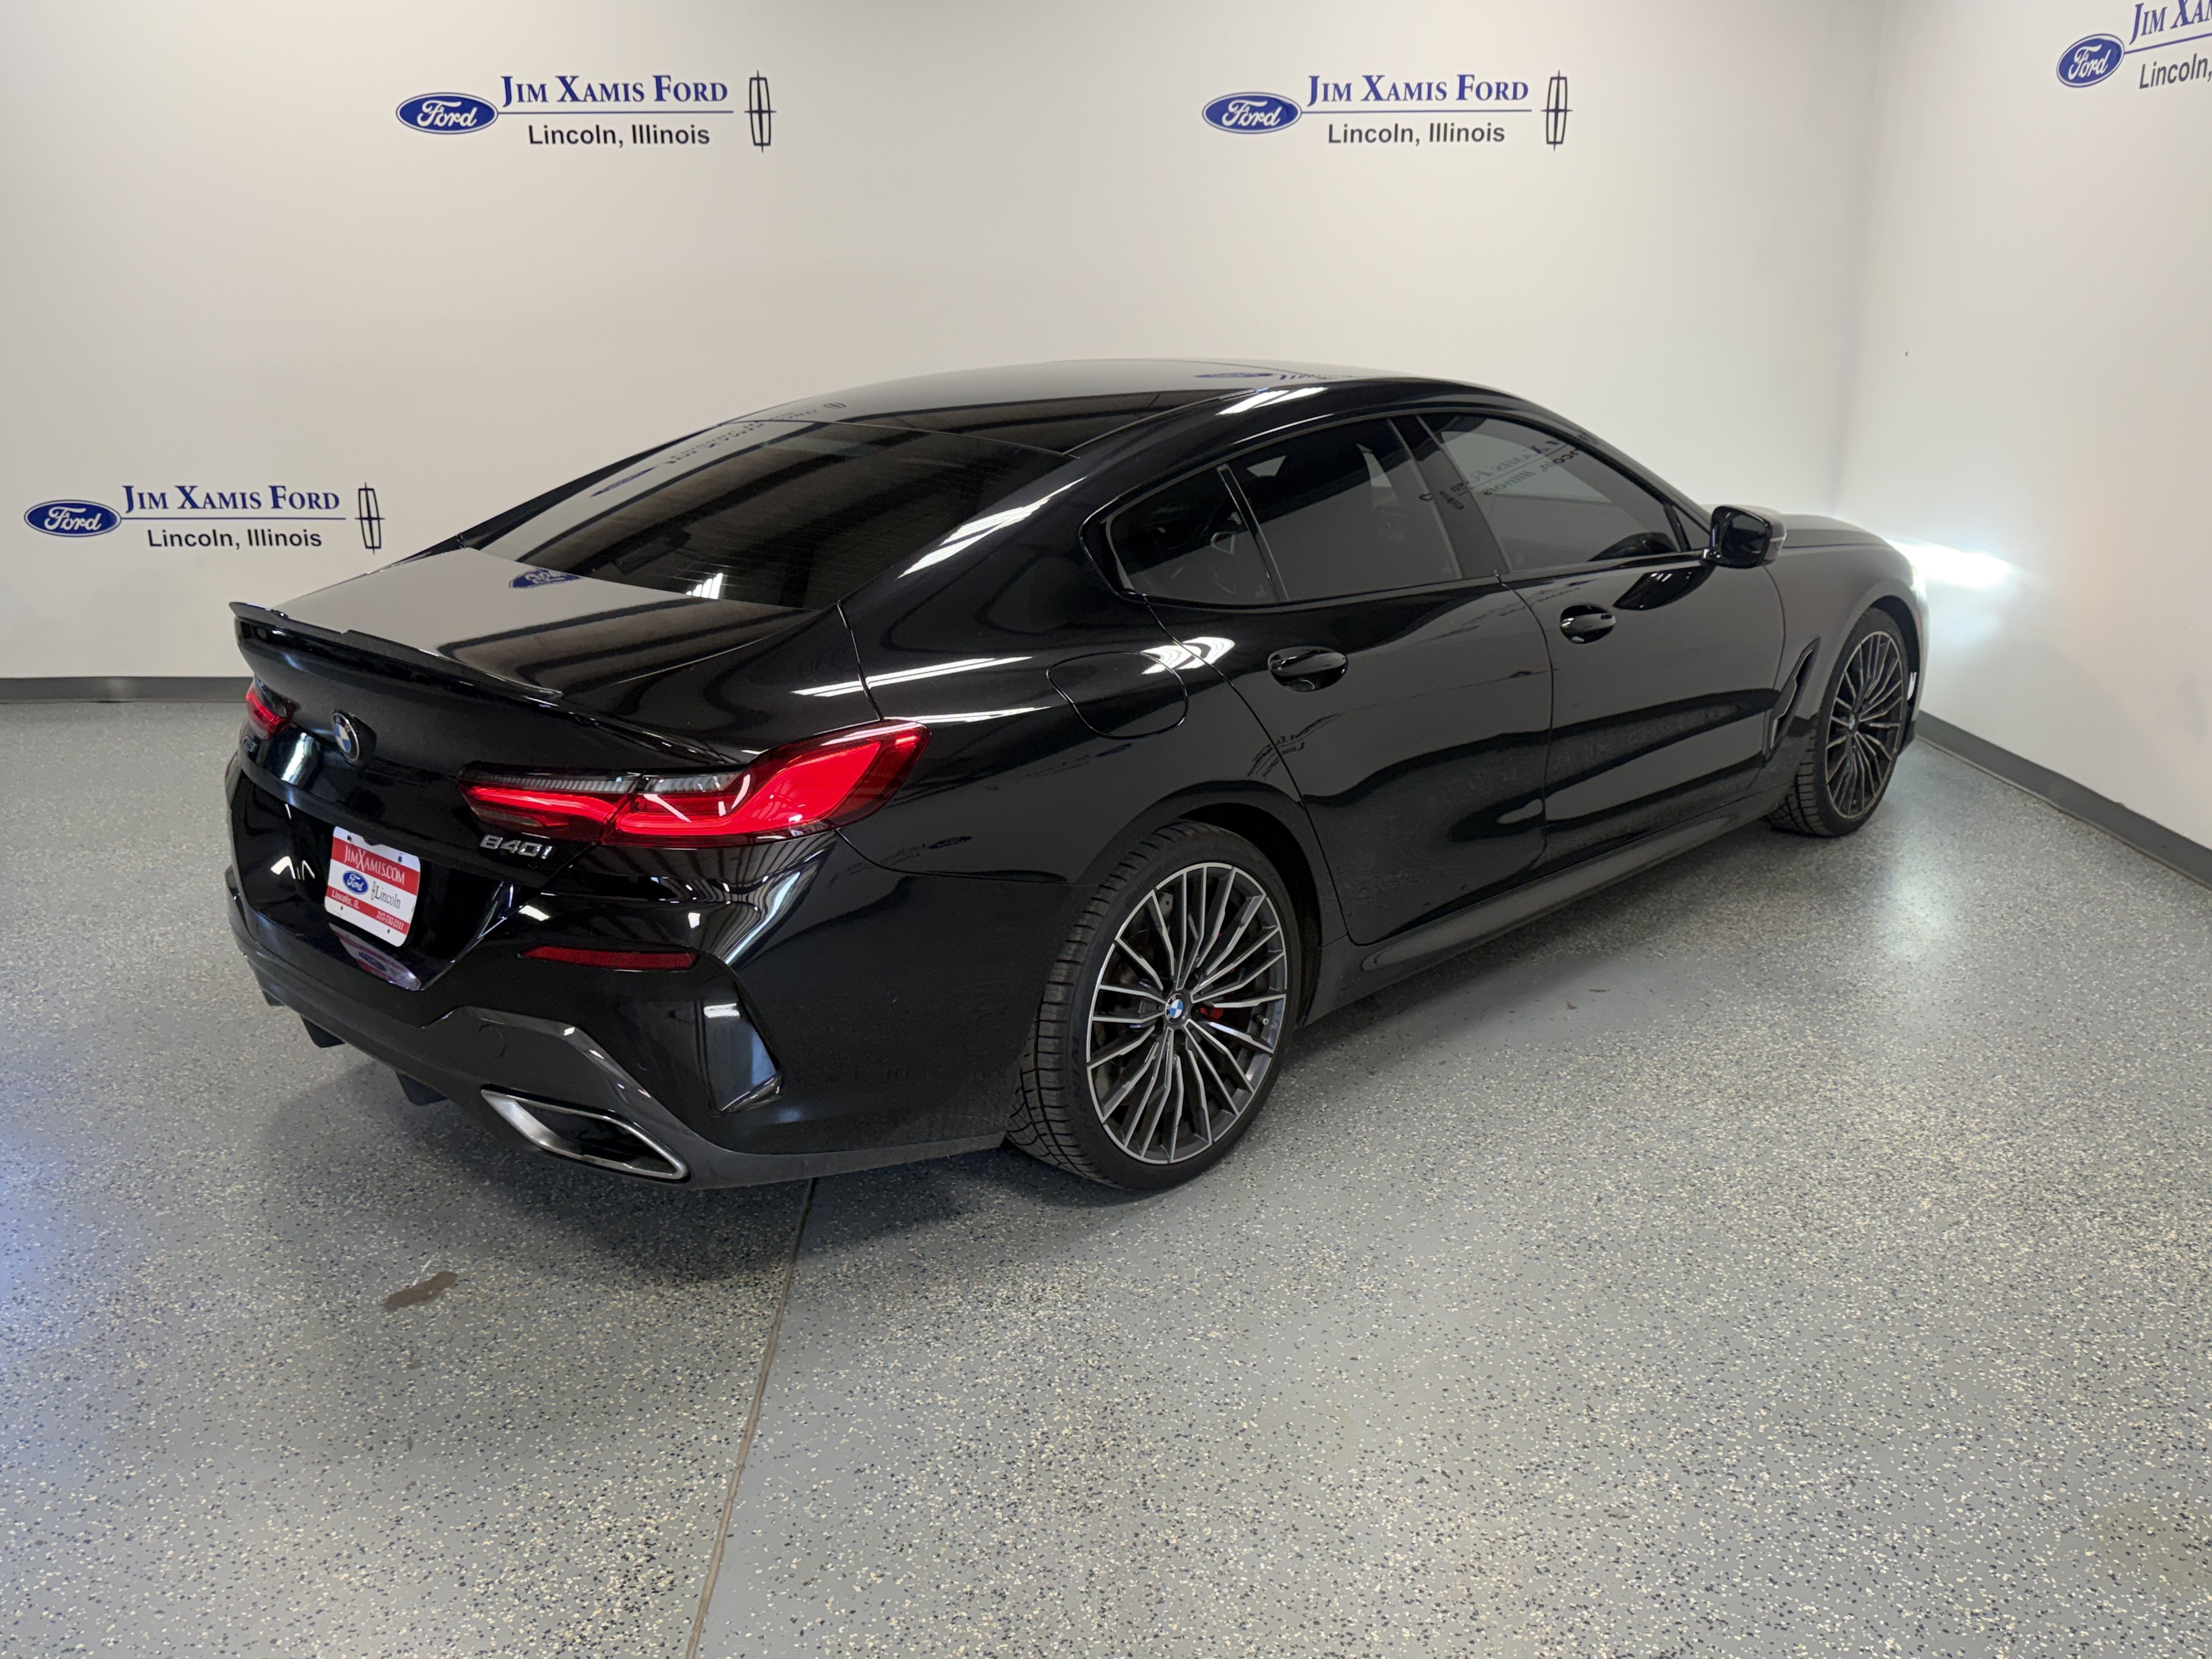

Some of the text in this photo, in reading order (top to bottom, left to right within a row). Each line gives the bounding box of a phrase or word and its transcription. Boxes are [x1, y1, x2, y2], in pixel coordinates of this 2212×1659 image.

[2129, 2, 2168, 45] JIM
[2068, 43, 2112, 81] Ford
[2138, 53, 2212, 89] Lincoln,
[500, 75, 728, 108] JIM XAMIS FORD
[1307, 74, 1528, 108] JIM XAMIS FORD
[416, 99, 478, 127] Ford
[1221, 99, 1283, 127] Ford
[528, 124, 710, 148] Lincoln, Illinois
[1328, 122, 1505, 146] Lincoln, Illinois
[122, 485, 340, 514] JIM XAMIS FORD
[44, 506, 102, 531] Ford
[147, 528, 322, 550] Lincoln, Illinois
[346, 873, 364, 891] Ford
[375, 885, 401, 909] Lincoln
